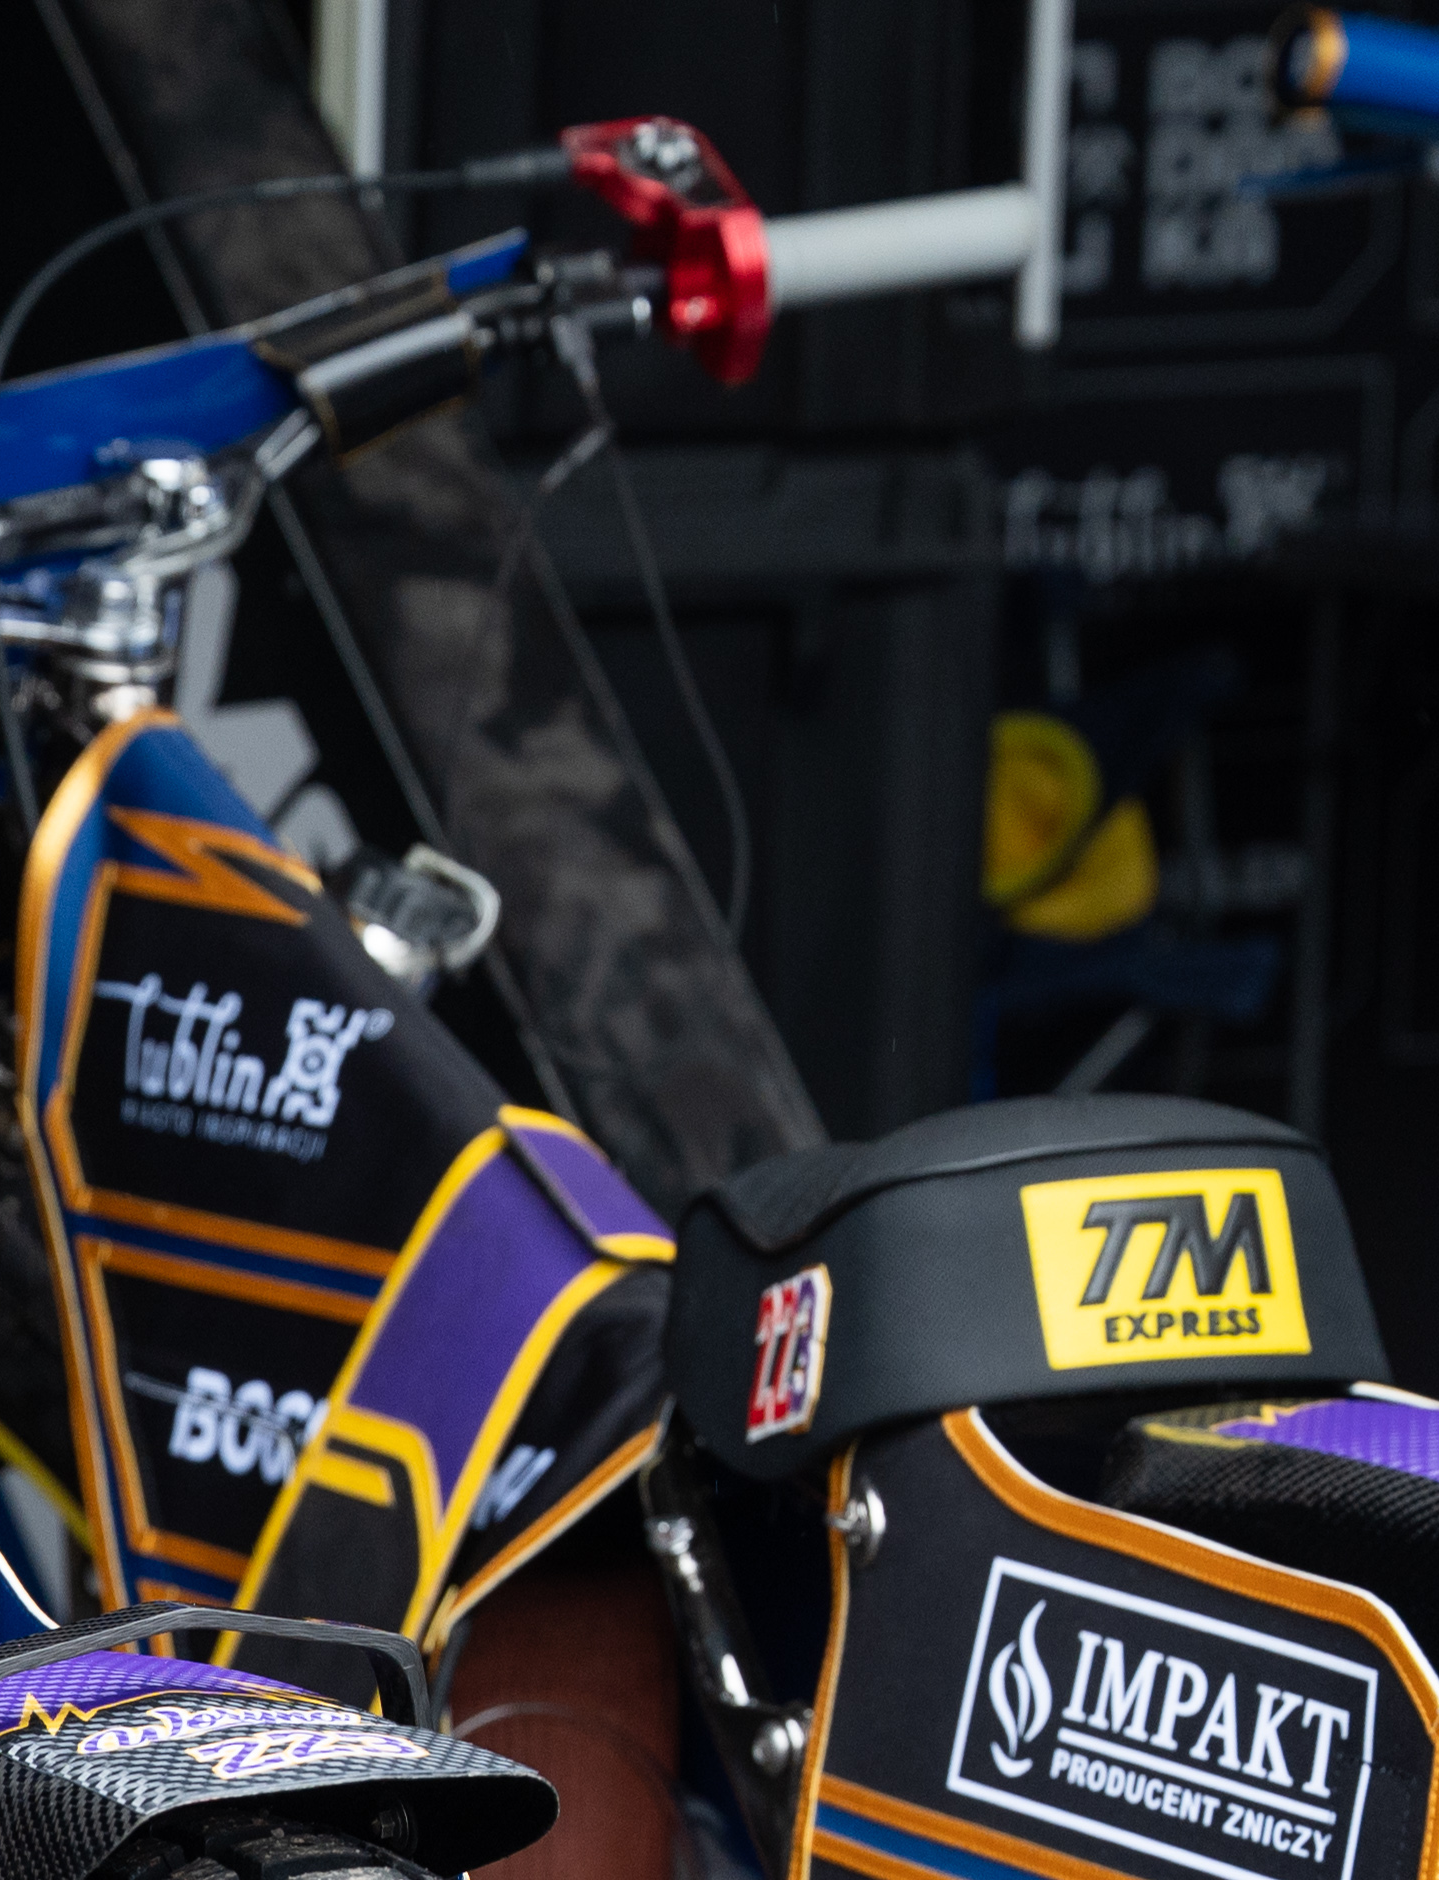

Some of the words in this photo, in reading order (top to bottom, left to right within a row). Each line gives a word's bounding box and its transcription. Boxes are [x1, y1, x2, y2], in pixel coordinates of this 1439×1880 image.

[1080, 1192, 1273, 1308] TM
[1105, 1307, 1262, 1344] EXPRESS
[184, 1729, 430, 1781] 223
[1062, 1630, 1350, 1798] IMPAKT
[1050, 1747, 1219, 1828] PRODUCENT
[1222, 1803, 1333, 1864] ZNICZY
